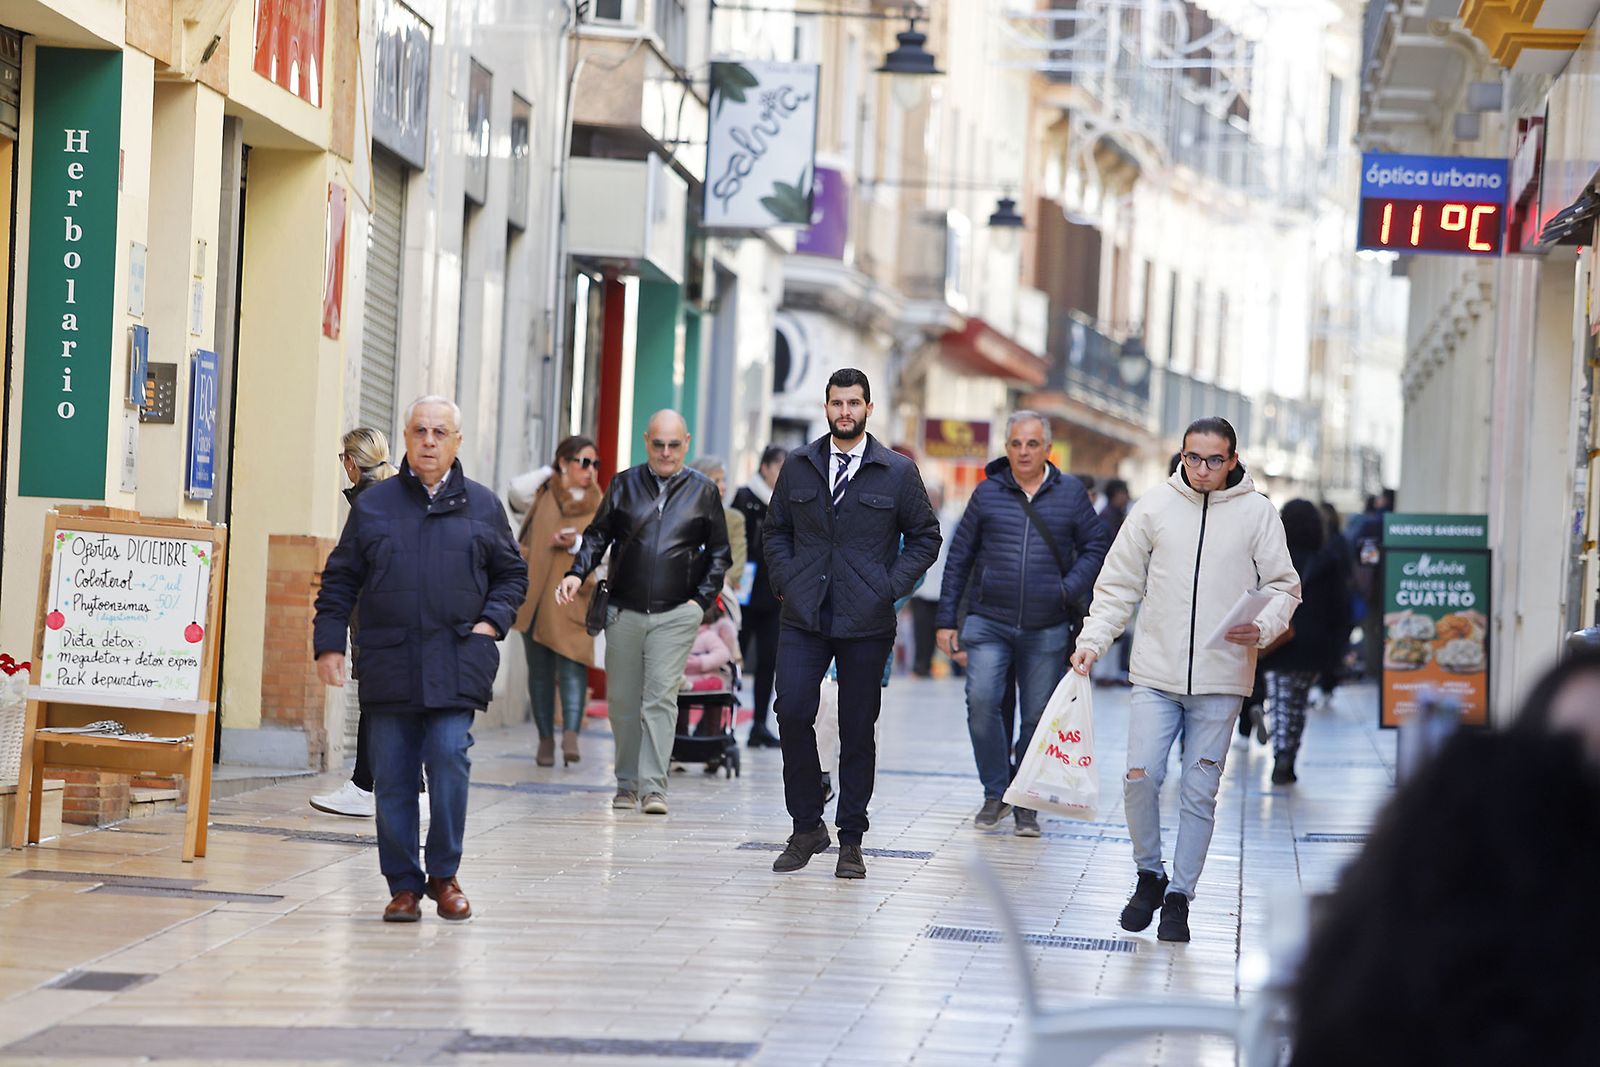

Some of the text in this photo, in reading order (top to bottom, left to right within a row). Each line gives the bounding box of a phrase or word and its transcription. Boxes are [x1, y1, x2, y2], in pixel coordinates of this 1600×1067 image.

[1366, 162, 1502, 190] óptica urbano
[56, 129, 90, 419] Herbolario
[1389, 523, 1484, 538] NUEVOS SABORES
[72, 534, 188, 567] Ofertas DICIEMBRE
[74, 568, 133, 591] Colesterol
[1399, 579, 1472, 592] FELICES LOS
[73, 592, 151, 617] Phytoenzimas
[1395, 590, 1476, 608] CUATRO
[63, 628, 96, 648] Dieta
[57, 650, 121, 669] megadetox
[135, 650, 165, 667] detox
[91, 670, 157, 688] depurativo
